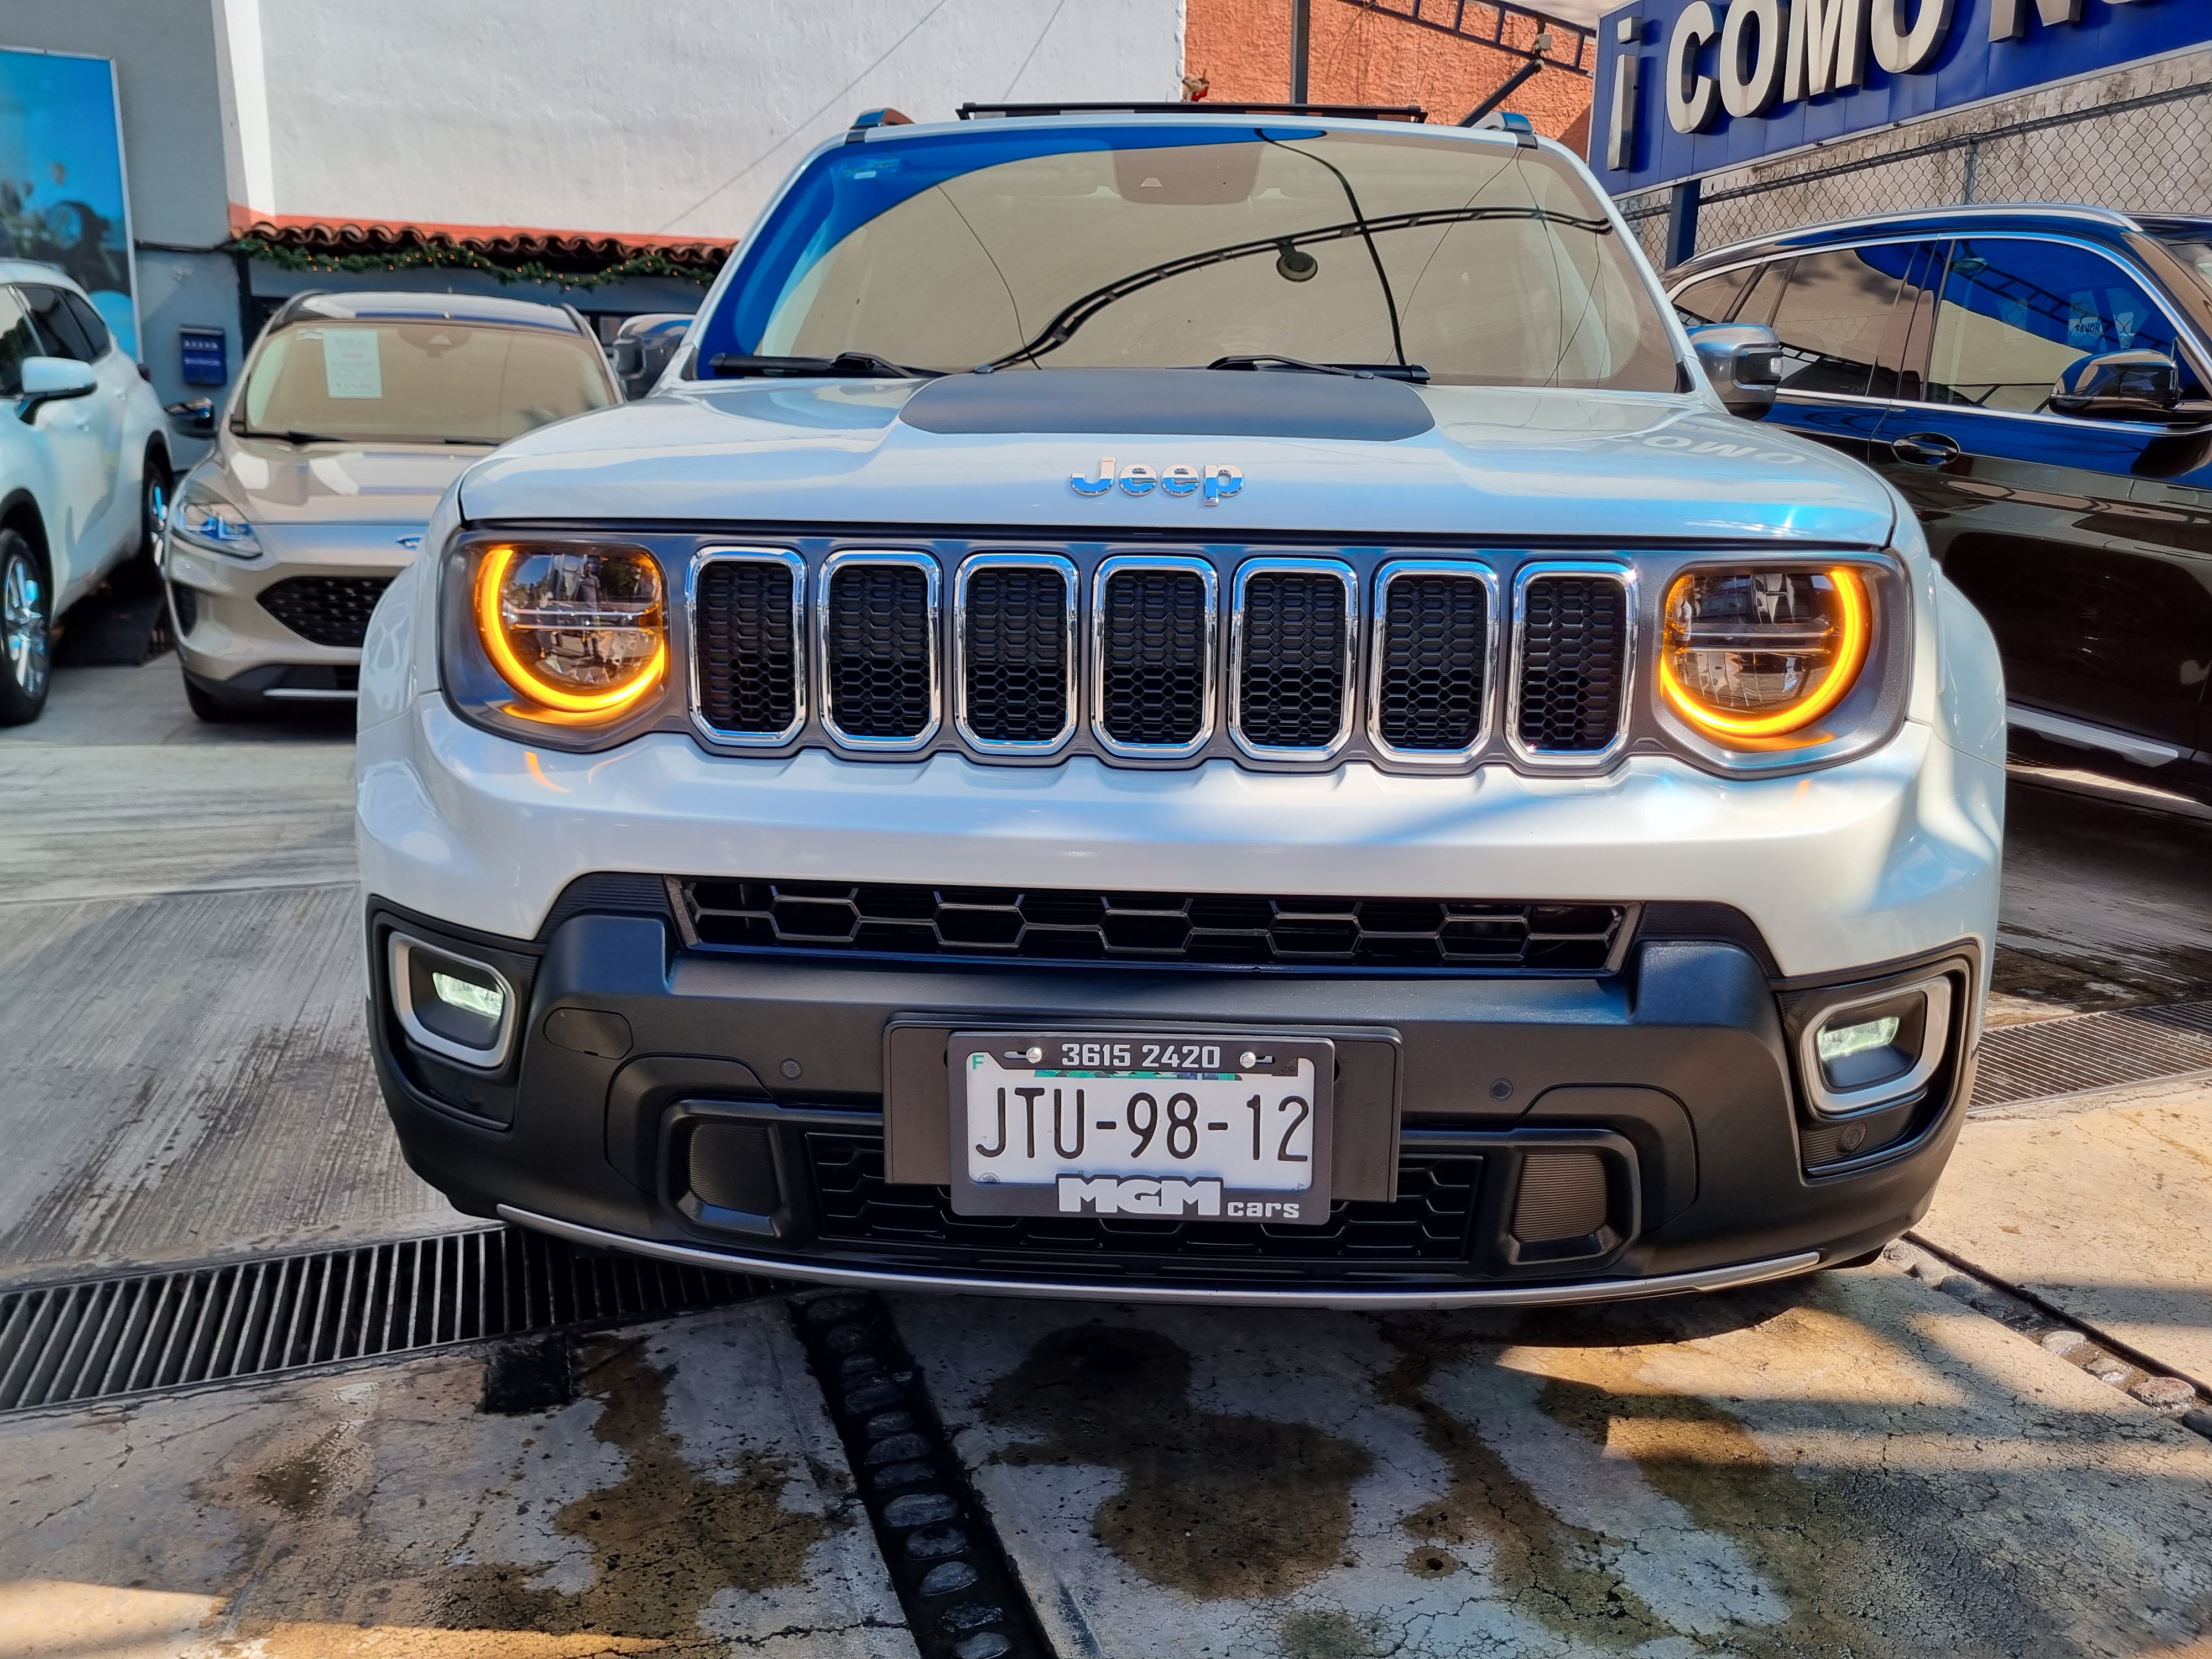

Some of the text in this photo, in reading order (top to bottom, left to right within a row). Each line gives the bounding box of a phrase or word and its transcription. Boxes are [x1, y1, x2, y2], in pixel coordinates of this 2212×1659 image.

[1070, 456, 1245, 506] Jeep
[972, 1055, 984, 1070] F
[1062, 1044, 1220, 1068] 3615 2420
[975, 1087, 1310, 1162] JTU-98-12
[1058, 1177, 1300, 1218] MGM cars
